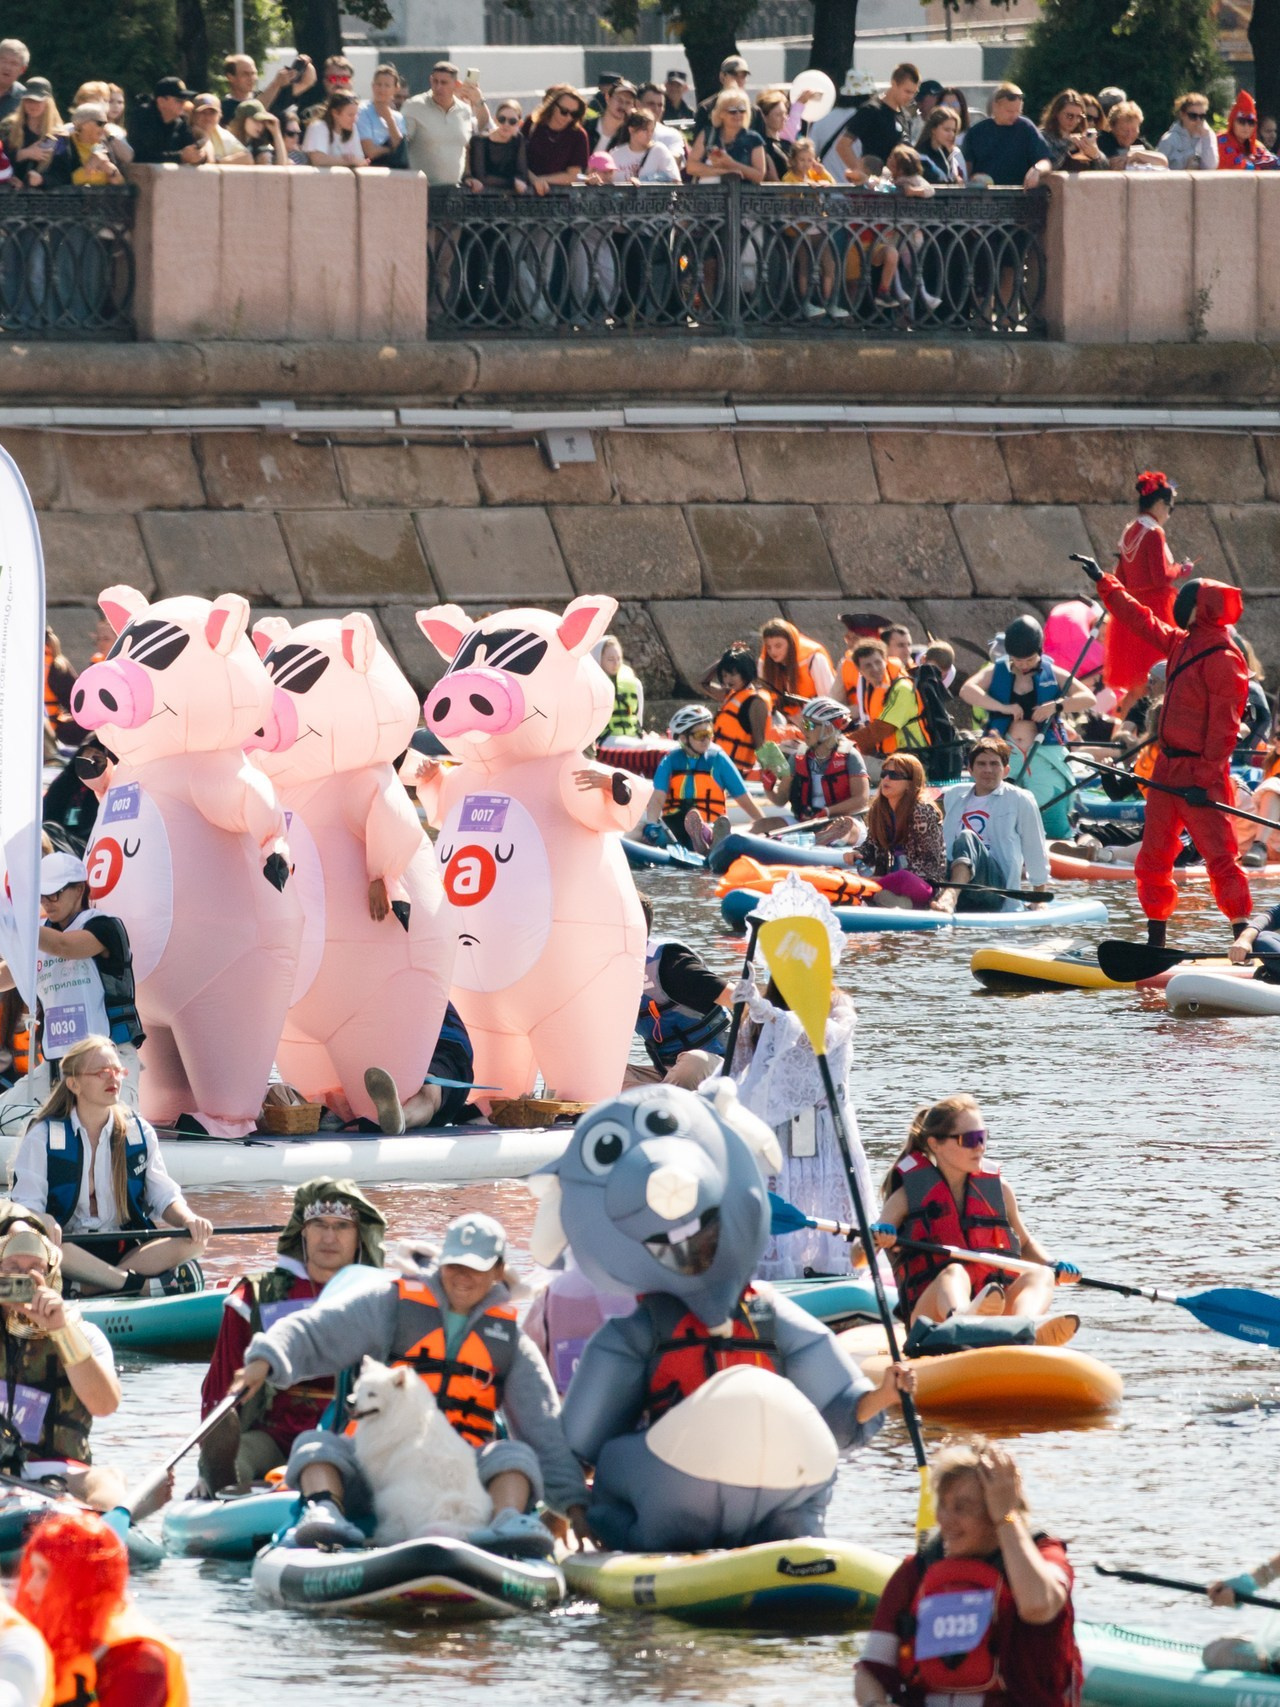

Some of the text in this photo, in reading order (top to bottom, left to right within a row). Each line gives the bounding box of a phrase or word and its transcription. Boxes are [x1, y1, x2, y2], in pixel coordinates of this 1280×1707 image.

[111, 797, 132, 812] 0013
[470, 808, 495, 823] 0017
[50, 1019, 77, 1037] 0030
[460, 1225, 476, 1246] C
[933, 1612, 978, 1640] 0325
